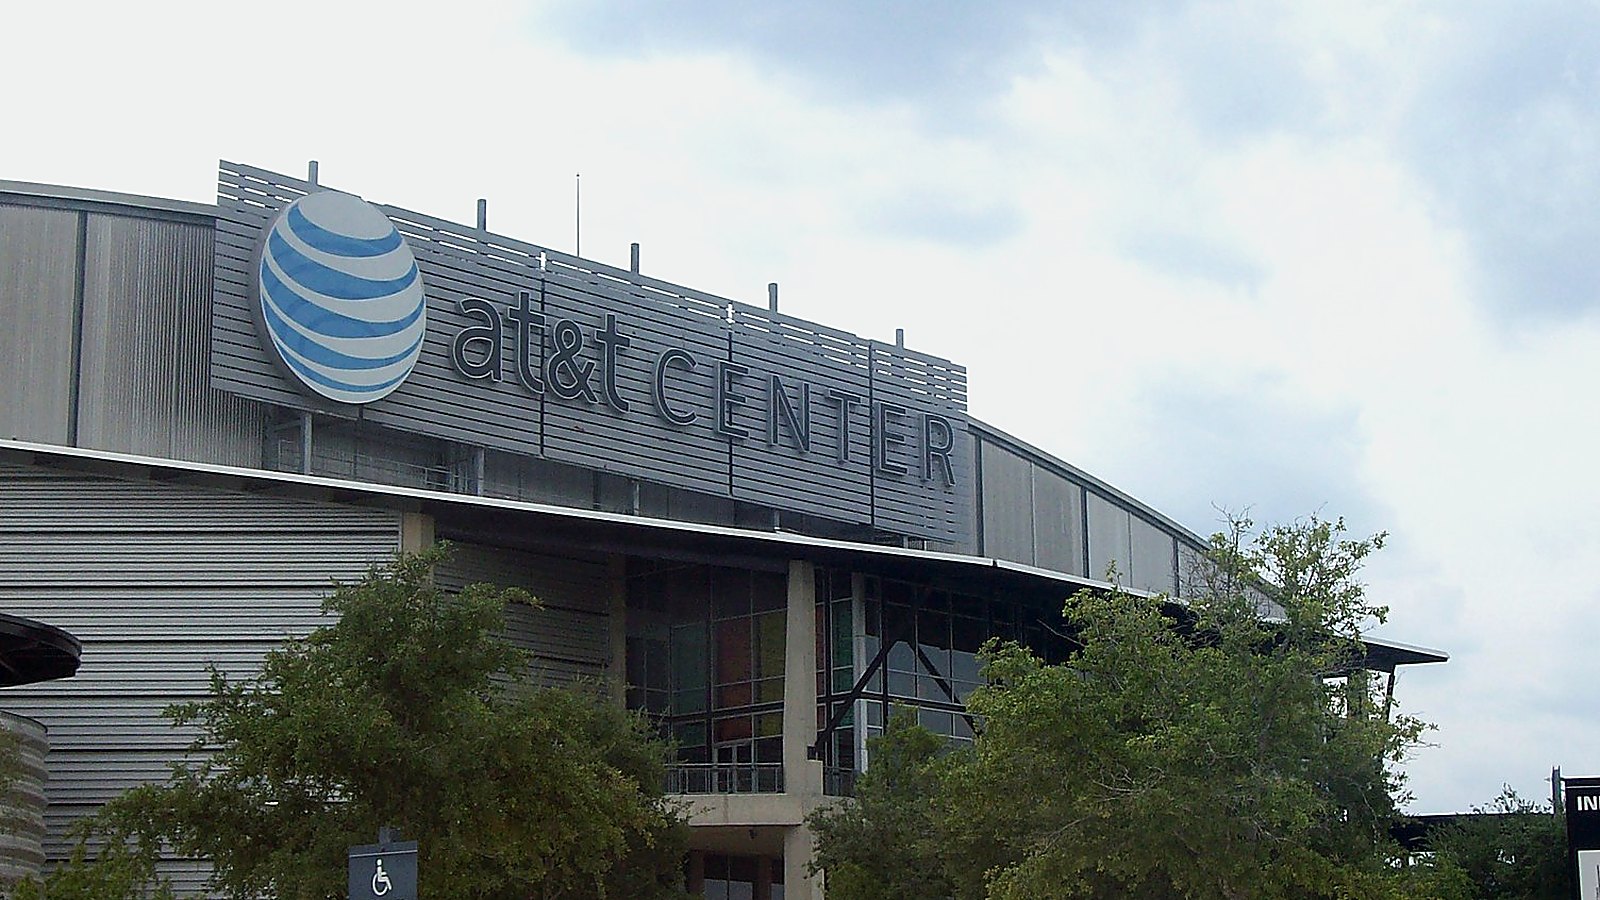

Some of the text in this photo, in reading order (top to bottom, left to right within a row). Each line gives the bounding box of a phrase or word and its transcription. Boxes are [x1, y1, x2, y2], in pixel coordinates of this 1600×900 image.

[452, 290, 955, 487] at&t CENTER
[1577, 795, 1600, 811] IN
